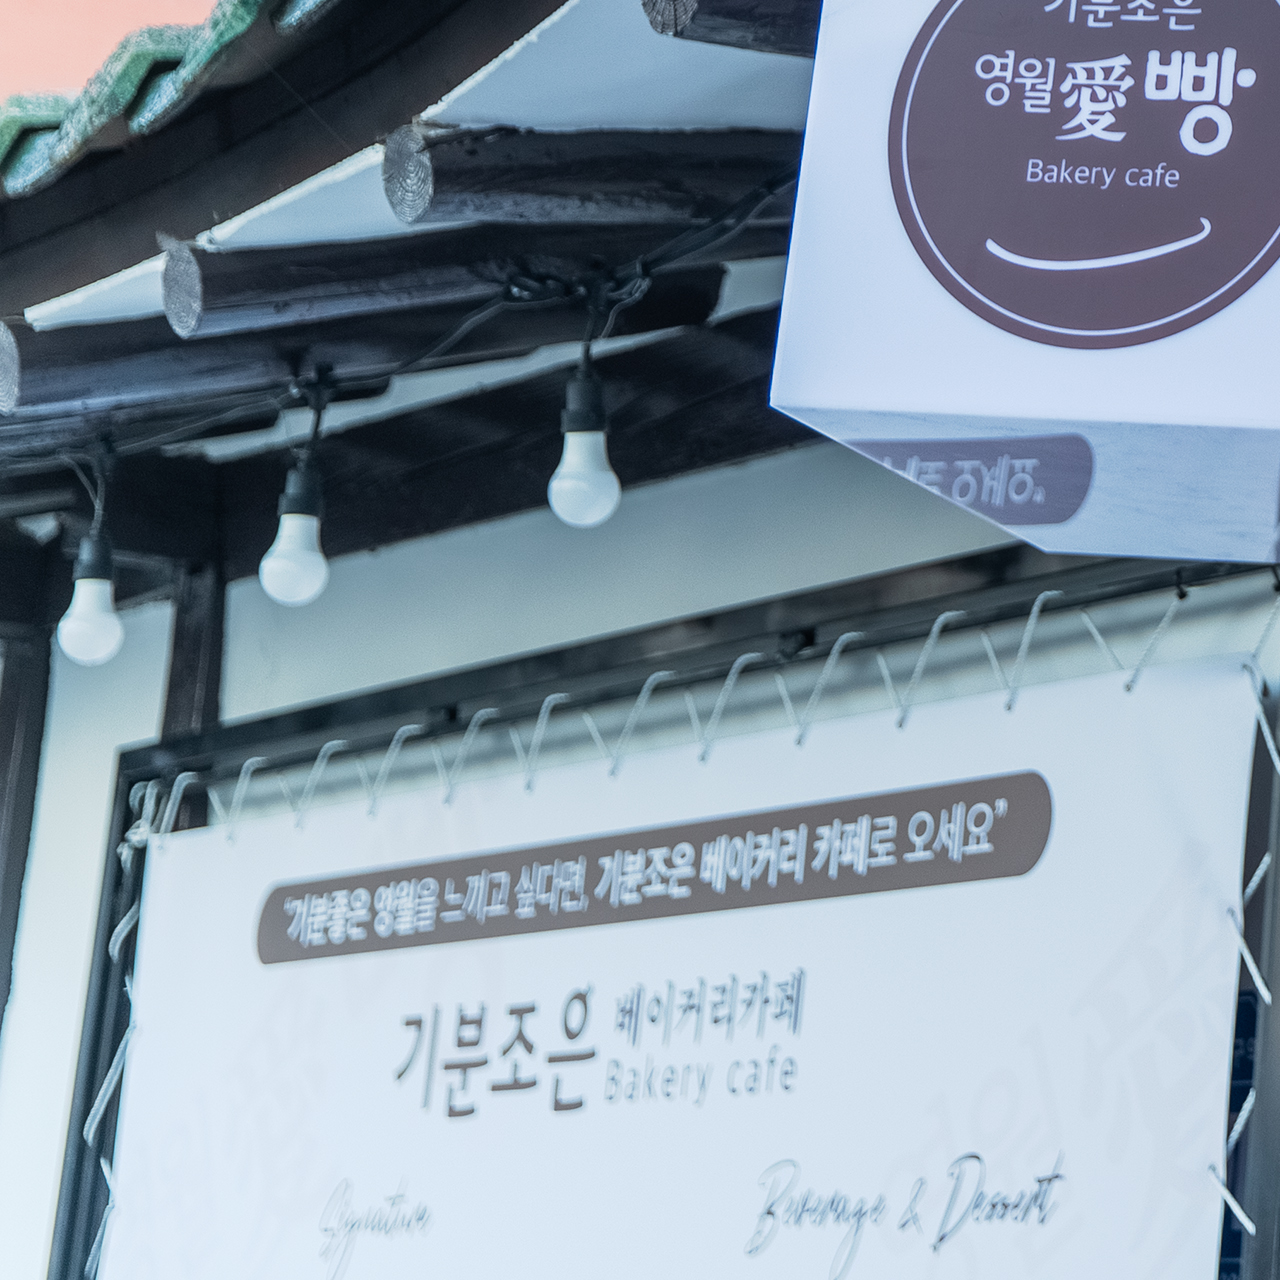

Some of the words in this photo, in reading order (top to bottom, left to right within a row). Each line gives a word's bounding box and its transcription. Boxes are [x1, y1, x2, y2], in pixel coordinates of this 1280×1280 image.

[1026, 158, 1116, 189] Bakery
[1125, 162, 1181, 187] cafe
[440, 869, 511, 924] 느끼고
[594, 841, 697, 908] 기분조은
[699, 823, 808, 894] 베이커리
[810, 814, 898, 880] 카페로
[394, 982, 596, 1118] 기분조은
[614, 966, 807, 1048] 베이커리카페
[604, 1052, 712, 1106] Bakery
[726, 1043, 799, 1095] cafe
[897, 1176, 926, 1236] &
[930, 1148, 1066, 1255] Dessert
